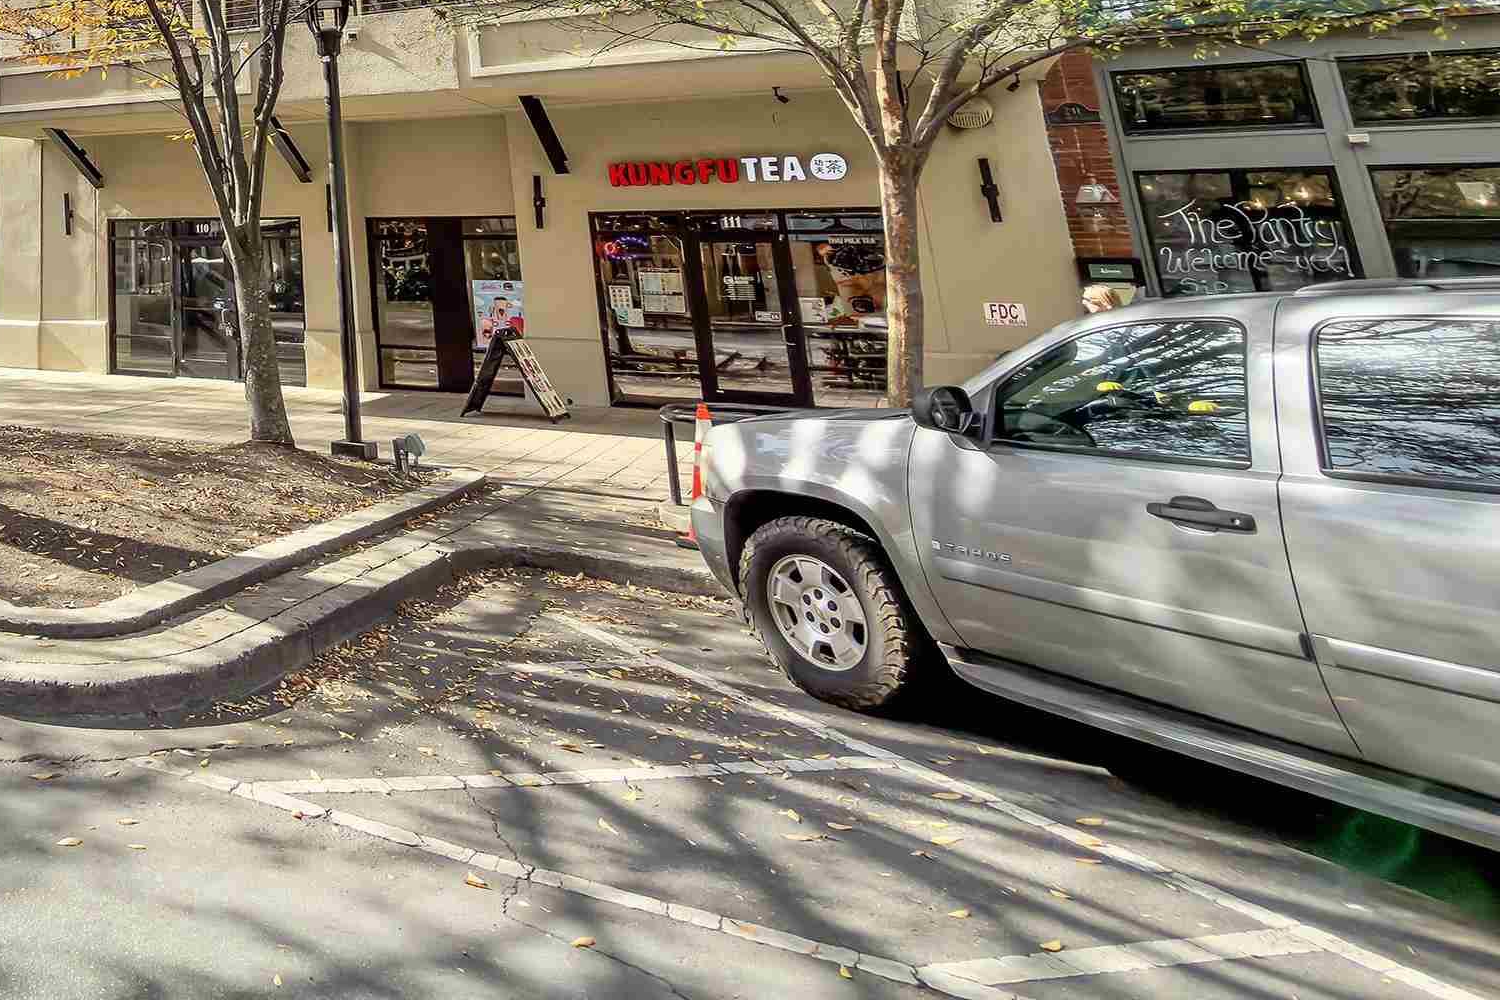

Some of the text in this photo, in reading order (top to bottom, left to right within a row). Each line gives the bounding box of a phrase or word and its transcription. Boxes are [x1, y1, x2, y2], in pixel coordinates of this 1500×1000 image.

[740, 155, 807, 183] TEA
[196, 223, 209, 233] 110
[723, 216, 741, 228] 111
[1158, 199, 1341, 258] The Pantry
[989, 303, 1019, 319] FDC
